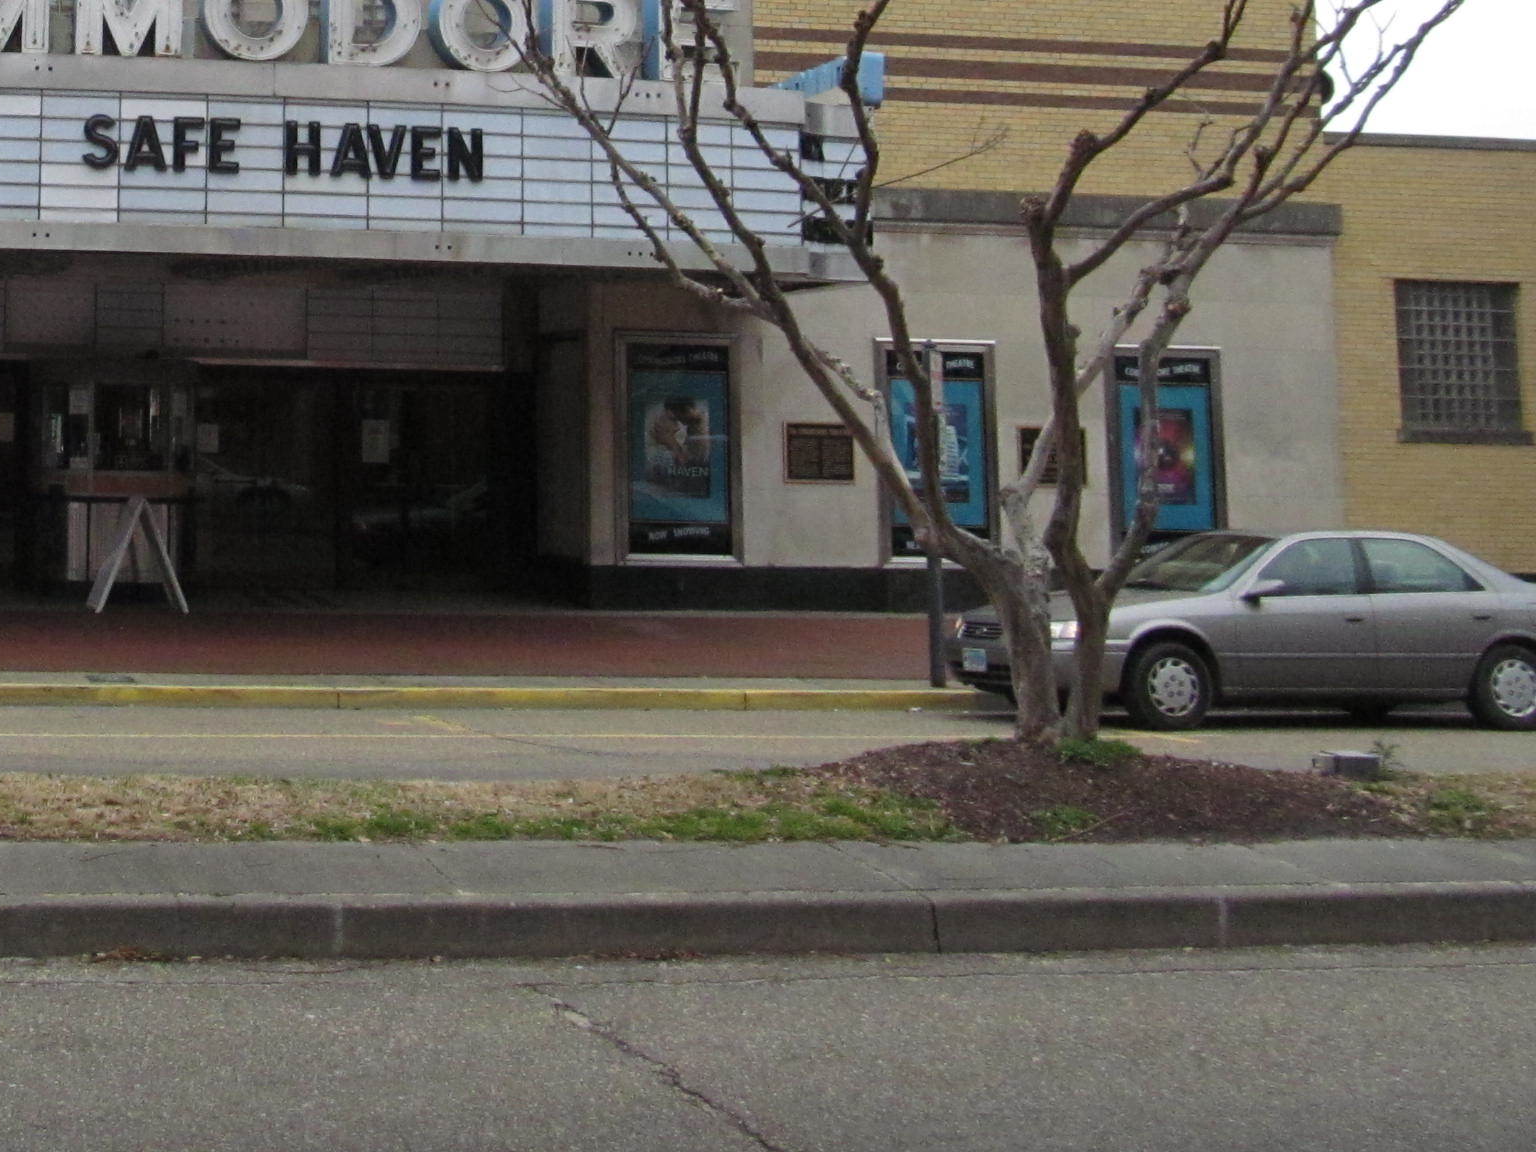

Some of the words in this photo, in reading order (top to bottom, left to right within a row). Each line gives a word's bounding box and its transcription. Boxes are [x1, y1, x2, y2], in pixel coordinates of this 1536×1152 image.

[82, 113, 241, 175] SAFE
[285, 119, 484, 183] HAVEN
[666, 466, 709, 477] HAVEN
